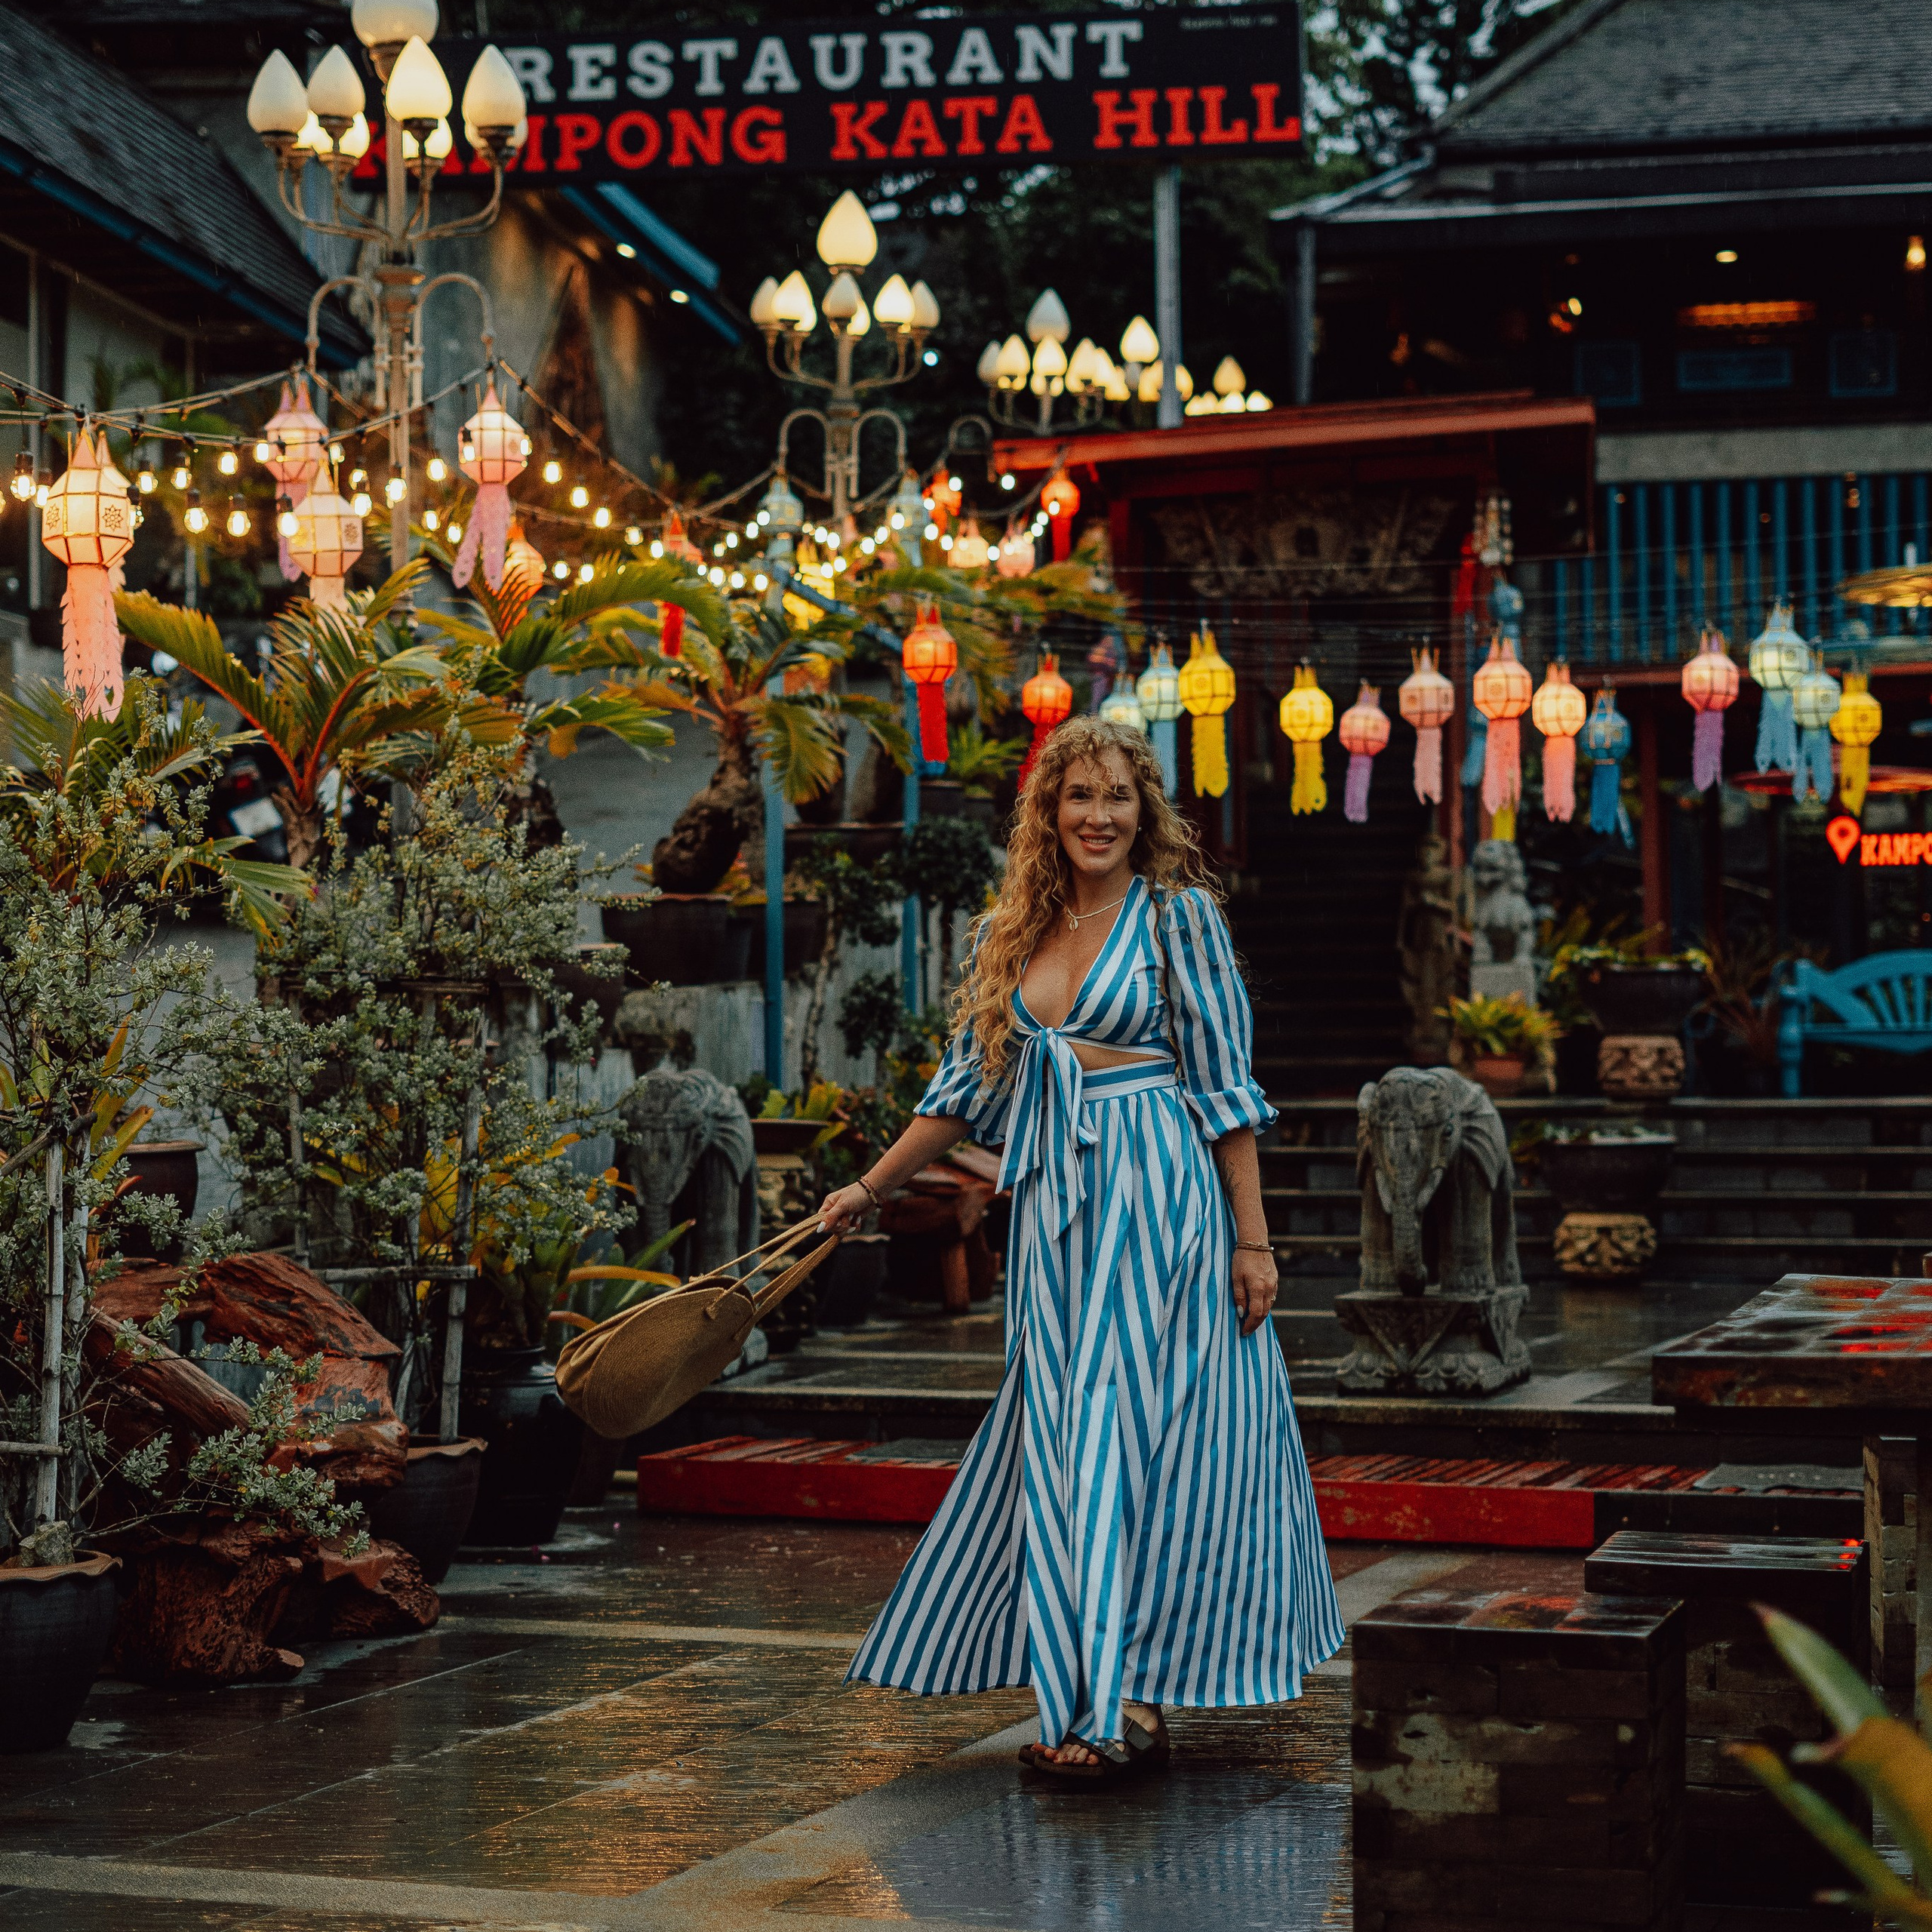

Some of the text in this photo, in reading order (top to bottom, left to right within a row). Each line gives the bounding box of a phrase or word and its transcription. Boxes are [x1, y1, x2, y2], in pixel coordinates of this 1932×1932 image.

[501, 20, 1143, 103] RESTAURANT
[352, 84, 1301, 177] MPONG KATA HILL
